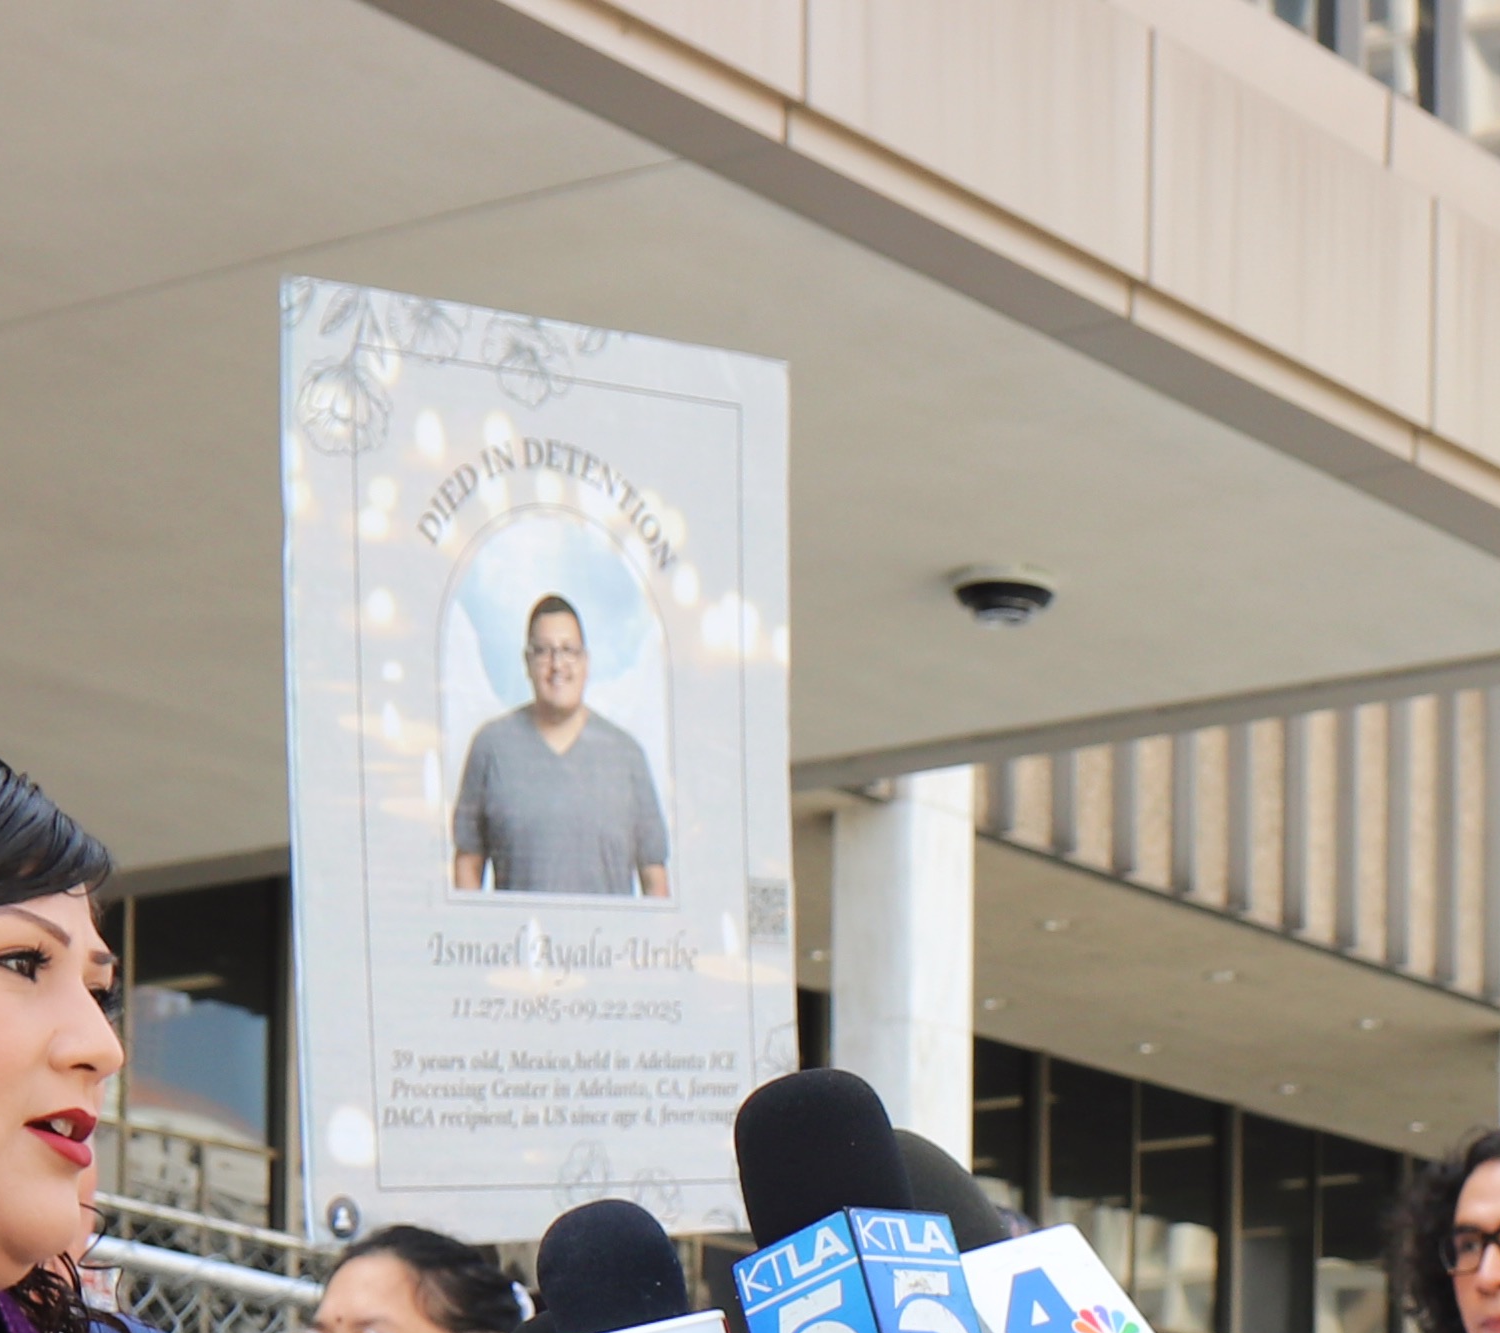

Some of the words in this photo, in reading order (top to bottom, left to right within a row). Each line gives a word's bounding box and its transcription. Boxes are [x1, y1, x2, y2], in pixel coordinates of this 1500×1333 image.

[416, 463, 480, 546] DIED
[484, 439, 518, 480] IN
[523, 437, 677, 570] DETENTION
[428, 924, 527, 967] Ismael
[739, 1226, 849, 1301] KTLA
[856, 1215, 954, 1254] KTLA
